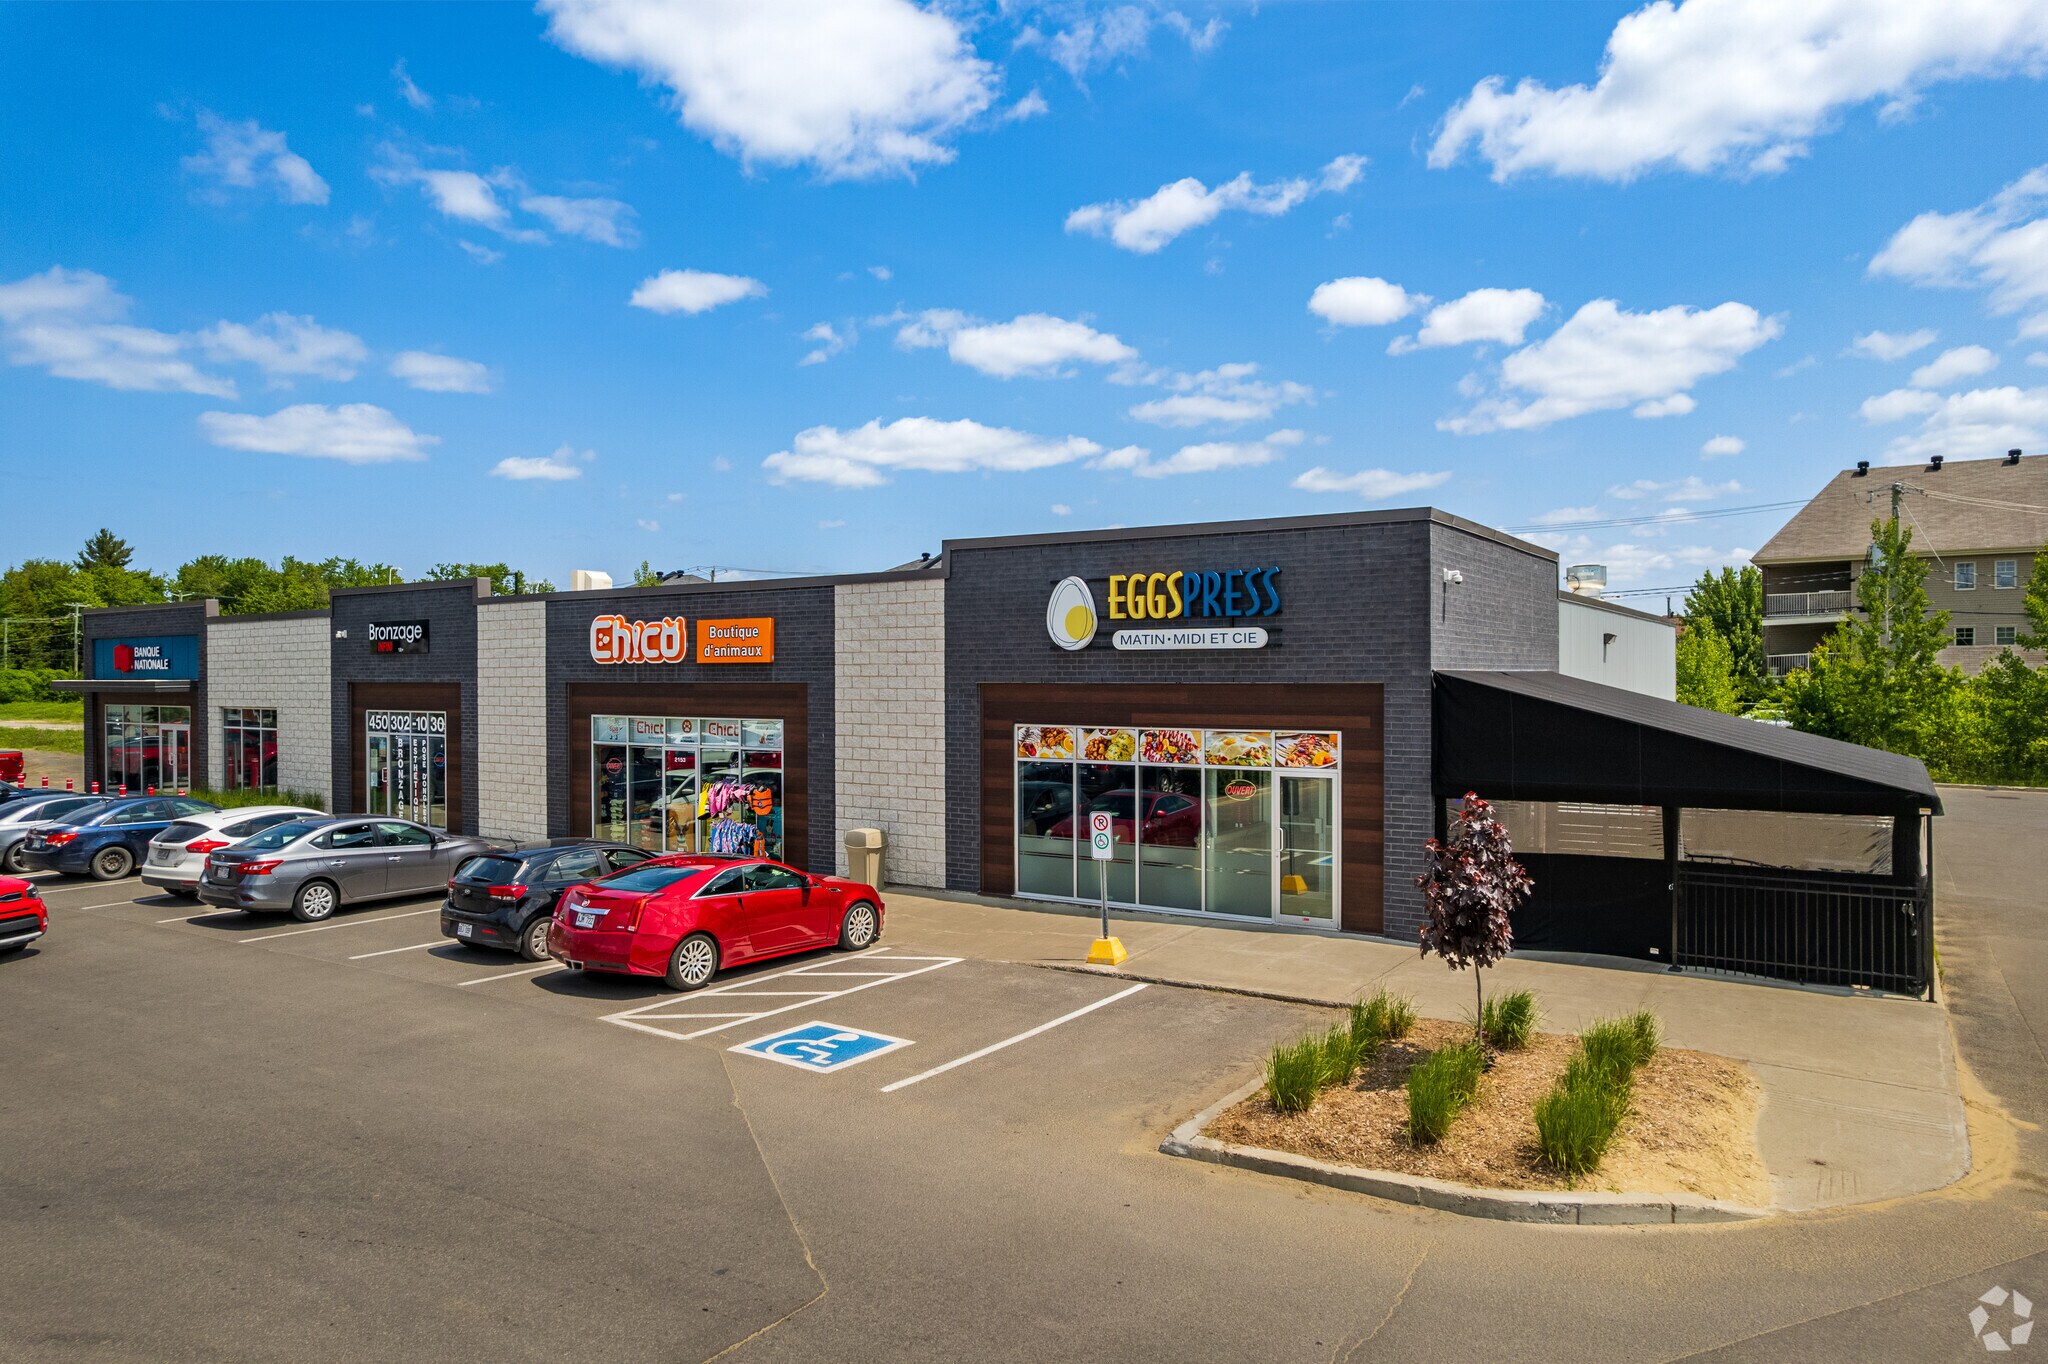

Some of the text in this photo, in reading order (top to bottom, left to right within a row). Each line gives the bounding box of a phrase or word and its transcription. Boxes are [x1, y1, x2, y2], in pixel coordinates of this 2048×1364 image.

[1108, 566, 1281, 619] EGGSPRESS
[369, 623, 422, 643] Bronzage
[590, 615, 687, 664] Chico
[709, 625, 759, 640] Boutique
[1211, 632, 1229, 644] ET
[1235, 632, 1257, 644] CIE
[134, 646, 160, 657] BANQUE
[704, 644, 763, 657] d'animaux
[134, 658, 169, 670] NATIONALE
[369, 715, 388, 730] 450
[1226, 785, 1255, 795] OUVERT
